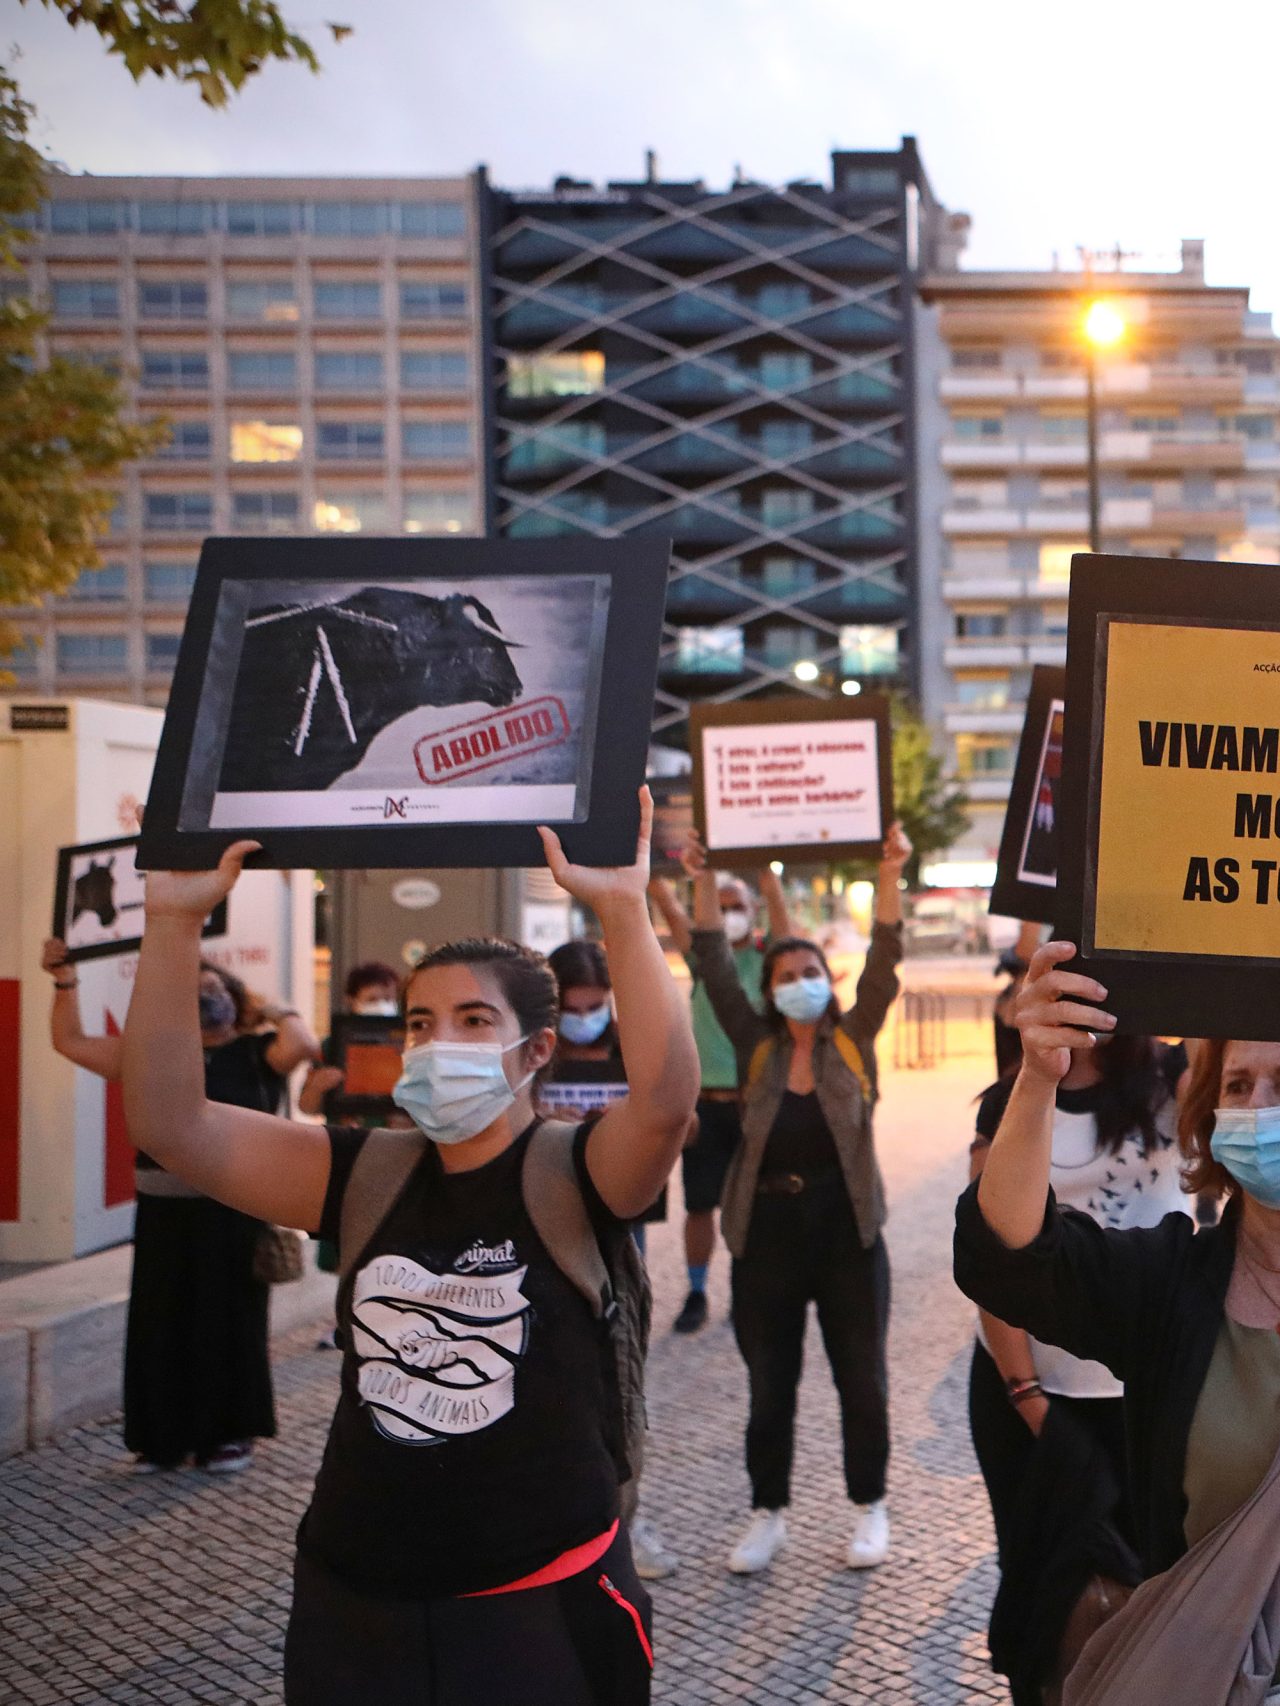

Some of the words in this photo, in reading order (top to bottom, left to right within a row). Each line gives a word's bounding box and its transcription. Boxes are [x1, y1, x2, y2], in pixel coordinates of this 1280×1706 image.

[431, 709, 554, 774] ABOLIDO
[1138, 720, 1280, 774] VIVAM
[1183, 856, 1239, 904] AS
[376, 1264, 421, 1292] TODOS
[424, 1281, 505, 1308] DIFERENTES
[416, 1391, 490, 1426] ANIMAIS
